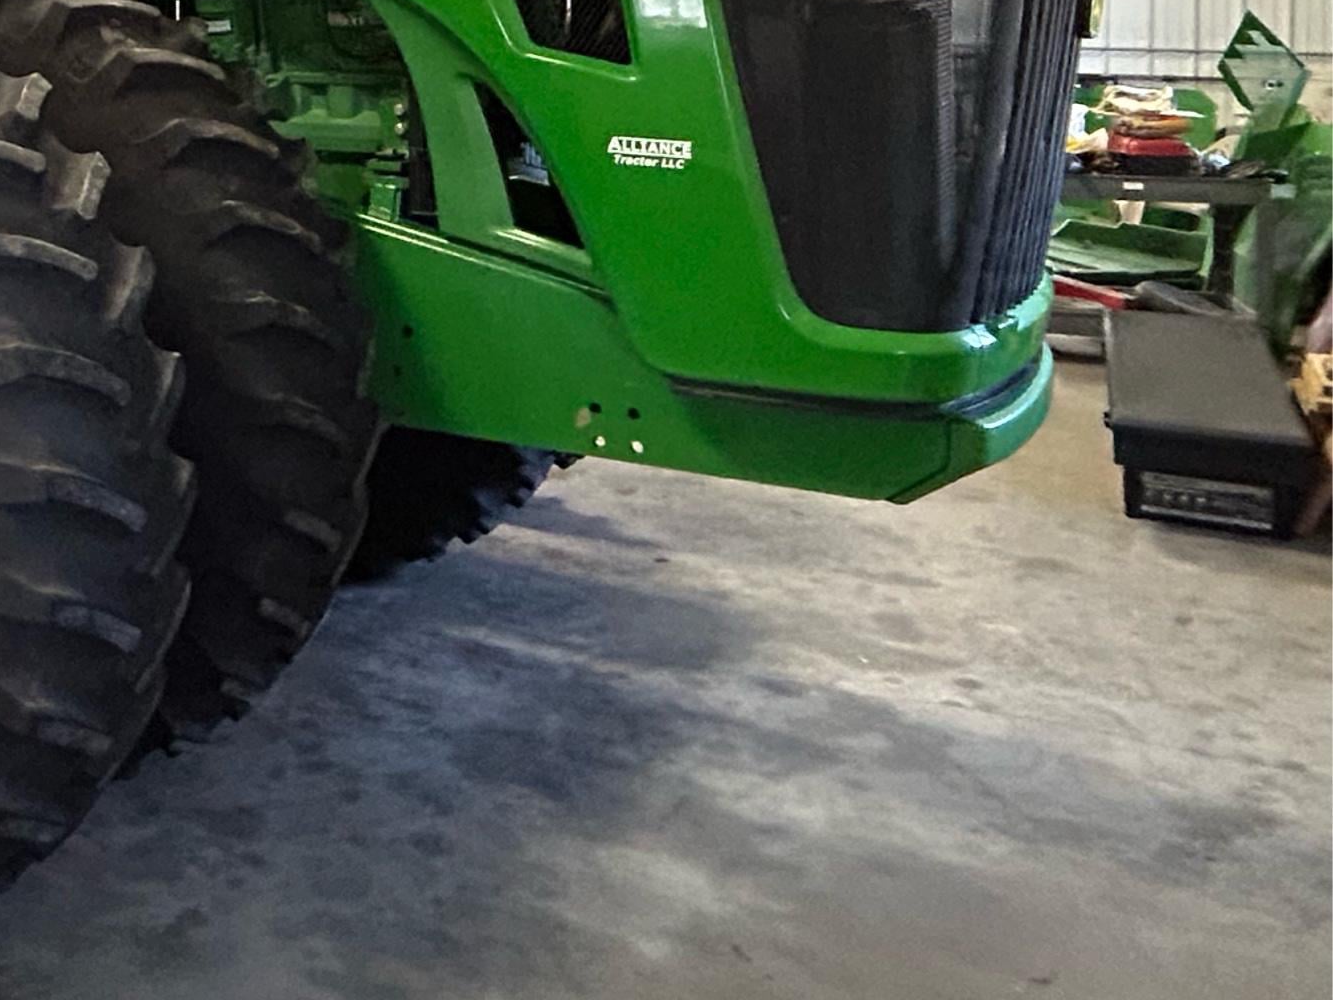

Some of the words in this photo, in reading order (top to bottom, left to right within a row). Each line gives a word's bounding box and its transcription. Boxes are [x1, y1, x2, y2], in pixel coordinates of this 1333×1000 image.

[607, 136, 692, 159] ALLIANCE
[613, 154, 659, 167] Tractor
[661, 158, 686, 170] LLC
